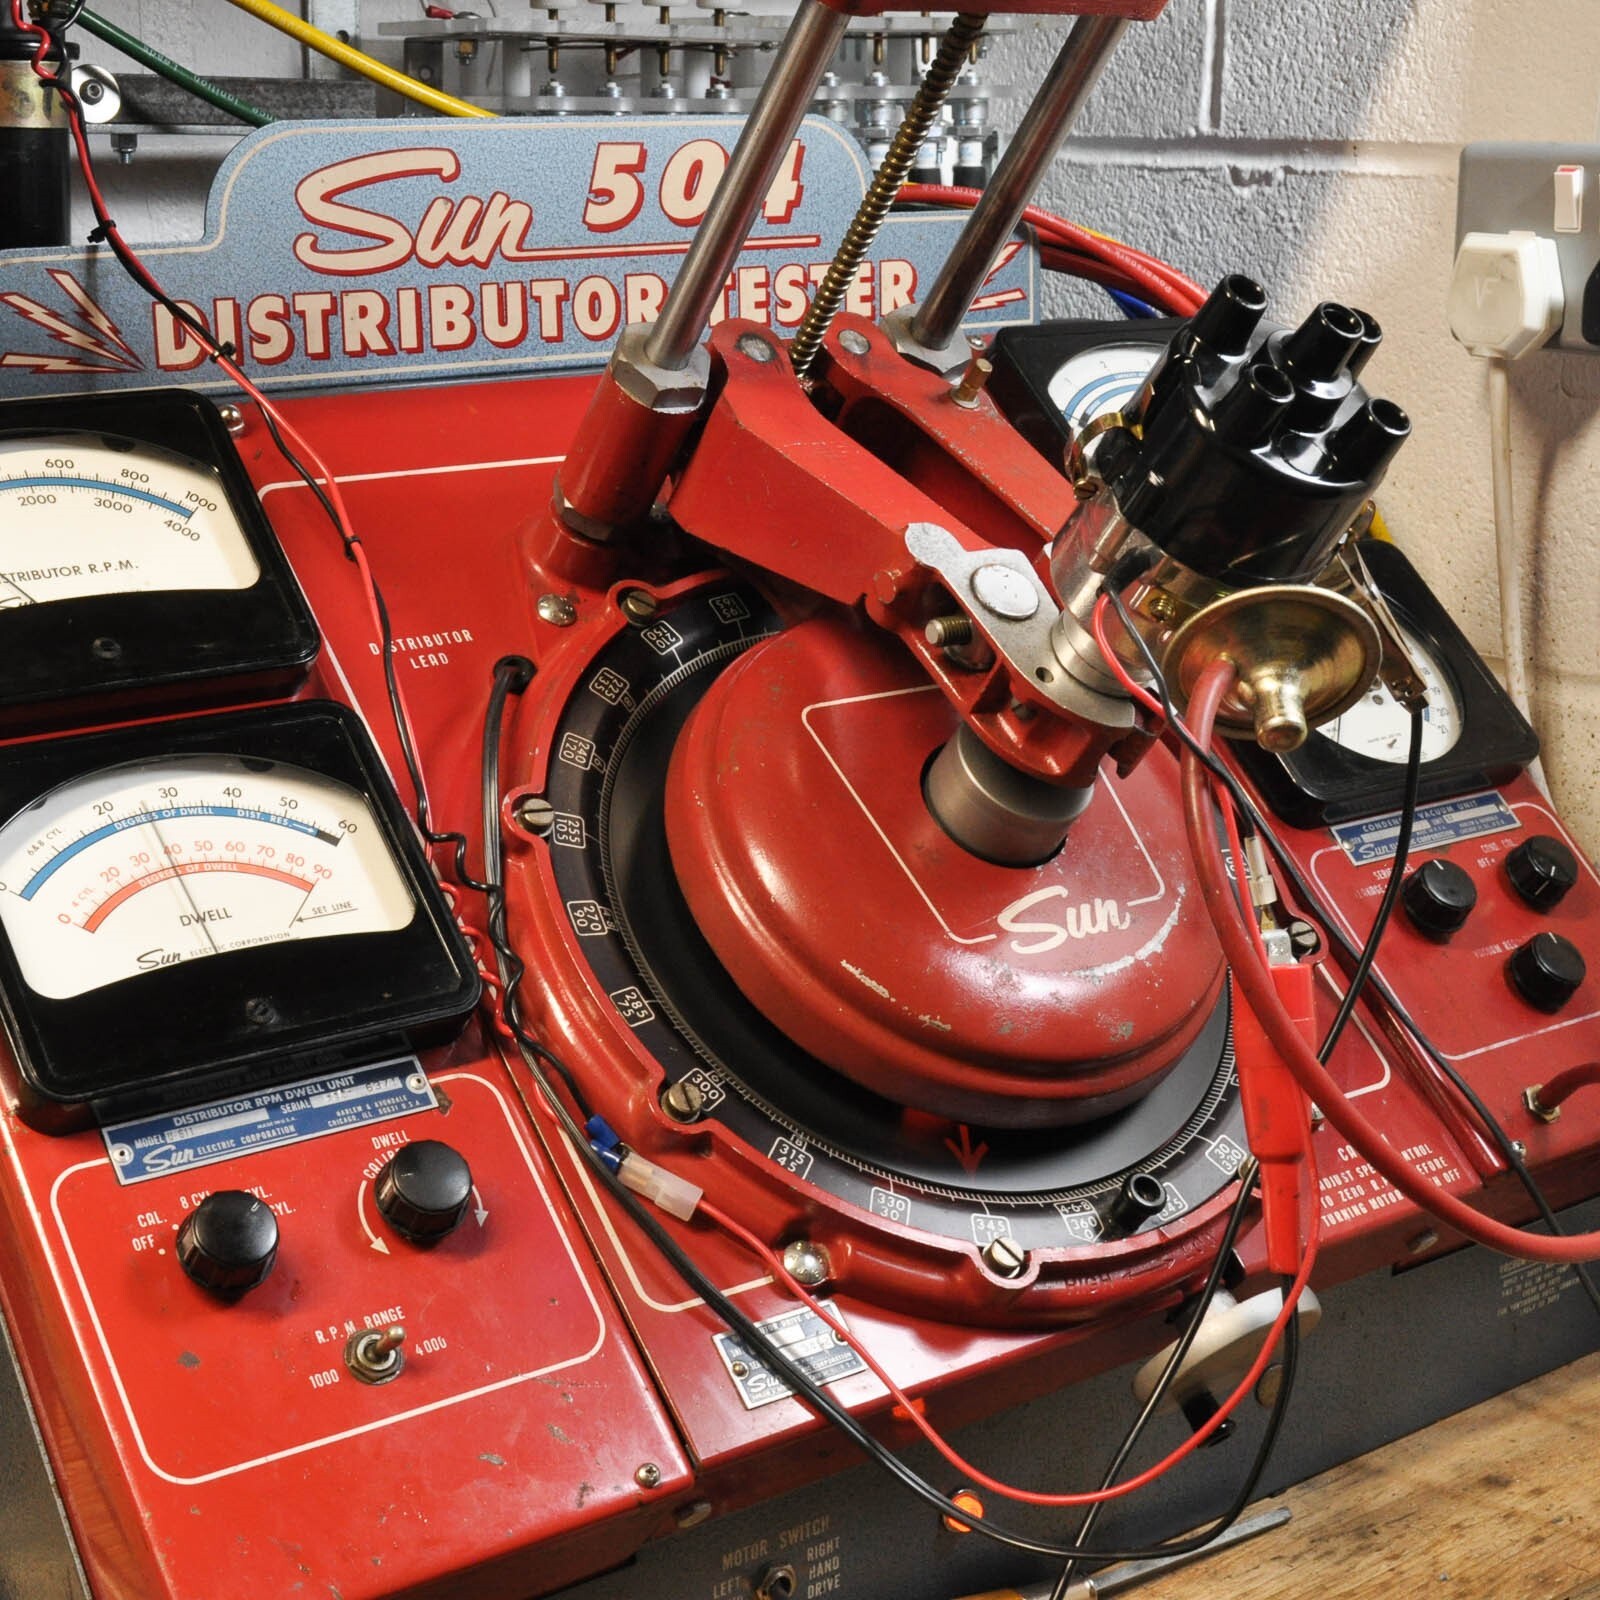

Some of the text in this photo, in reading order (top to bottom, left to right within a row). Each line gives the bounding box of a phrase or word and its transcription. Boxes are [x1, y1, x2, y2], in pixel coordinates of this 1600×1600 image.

[293, 147, 534, 276] Sun
[152, 268, 668, 373] DISTRIBUTOR
[44, 458, 75, 470] 600
[120, 468, 150, 484] 800
[17, 494, 57, 507] 2000
[93, 497, 133, 514] 3000
[184, 490, 218, 513] 1000
[163, 518, 201, 542] 4000
[88, 559, 139, 573] R.P.M.
[368, 629, 474, 656] DSTRIBUTOR
[409, 652, 449, 669] LEAD
[158, 786, 178, 799] 30
[223, 786, 242, 799] 40
[93, 801, 114, 816] 20
[279, 796, 298, 810] 50
[1417, 805, 1454, 819] VACUUM
[1458, 800, 1479, 811] UNIT
[114, 805, 214, 831] DEGREES OF DWELL
[237, 808, 293, 827] DIST. RES.
[337, 819, 358, 835] 60
[163, 843, 183, 856] 40
[194, 840, 213, 851] 50
[224, 840, 246, 852] 60
[256, 844, 276, 859] 70
[129, 852, 151, 867] 30
[186, 863, 200, 874] OF
[203, 861, 238, 872] DWELL
[285, 852, 306, 867] 80
[100, 866, 121, 883] 20
[313, 863, 333, 880] 90
[179, 906, 233, 928] DWELL
[311, 900, 353, 916] SET LINE
[57, 913, 72, 925] 0
[996, 884, 1131, 955] Sun
[136, 948, 183, 971] Sun
[625, 991, 649, 1018] 285
[692, 1073, 720, 1100] 300
[173, 1100, 253, 1127] DISTRIBUTOR
[254, 1093, 284, 1108] RPM
[285, 1082, 325, 1099] DWELL
[327, 1075, 356, 1091] UNIT
[280, 1099, 312, 1114] SERIAL
[134, 1134, 165, 1149] MODEL
[142, 1124, 297, 1173] Sun ELECTRIC CORPORATION
[371, 1129, 411, 1150] DWELL
[779, 1143, 806, 1165] 315
[1214, 1143, 1230, 1158] 30
[1222, 1150, 1243, 1171] 330
[1319, 1170, 1355, 1191] ADJUST
[1320, 1195, 1334, 1209] TO
[1337, 1183, 1366, 1203] ZERO
[1415, 1156, 1448, 1176] EFORE
[179, 1195, 190, 1209] 8
[877, 1193, 905, 1212] 330
[1320, 1202, 1368, 1228] TURNING
[1368, 1189, 1405, 1211] MOTOR
[1443, 1167, 1461, 1184] OFF
[136, 1210, 168, 1228] CAL.
[879, 1206, 900, 1222] 30
[1070, 1216, 1097, 1230] 360
[976, 1218, 1006, 1233] 345
[131, 1234, 155, 1252] OFF
[363, 1305, 406, 1330] RANGE
[415, 1335, 447, 1357] 4000
[308, 1368, 340, 1389] 1000
[722, 1514, 830, 1572] MOTOR SWITCH
[807, 1536, 841, 1562] RIGHT
[809, 1555, 840, 1581] HAND
[713, 1575, 742, 1600] LEFT
[807, 1573, 841, 1600] DRIVE
